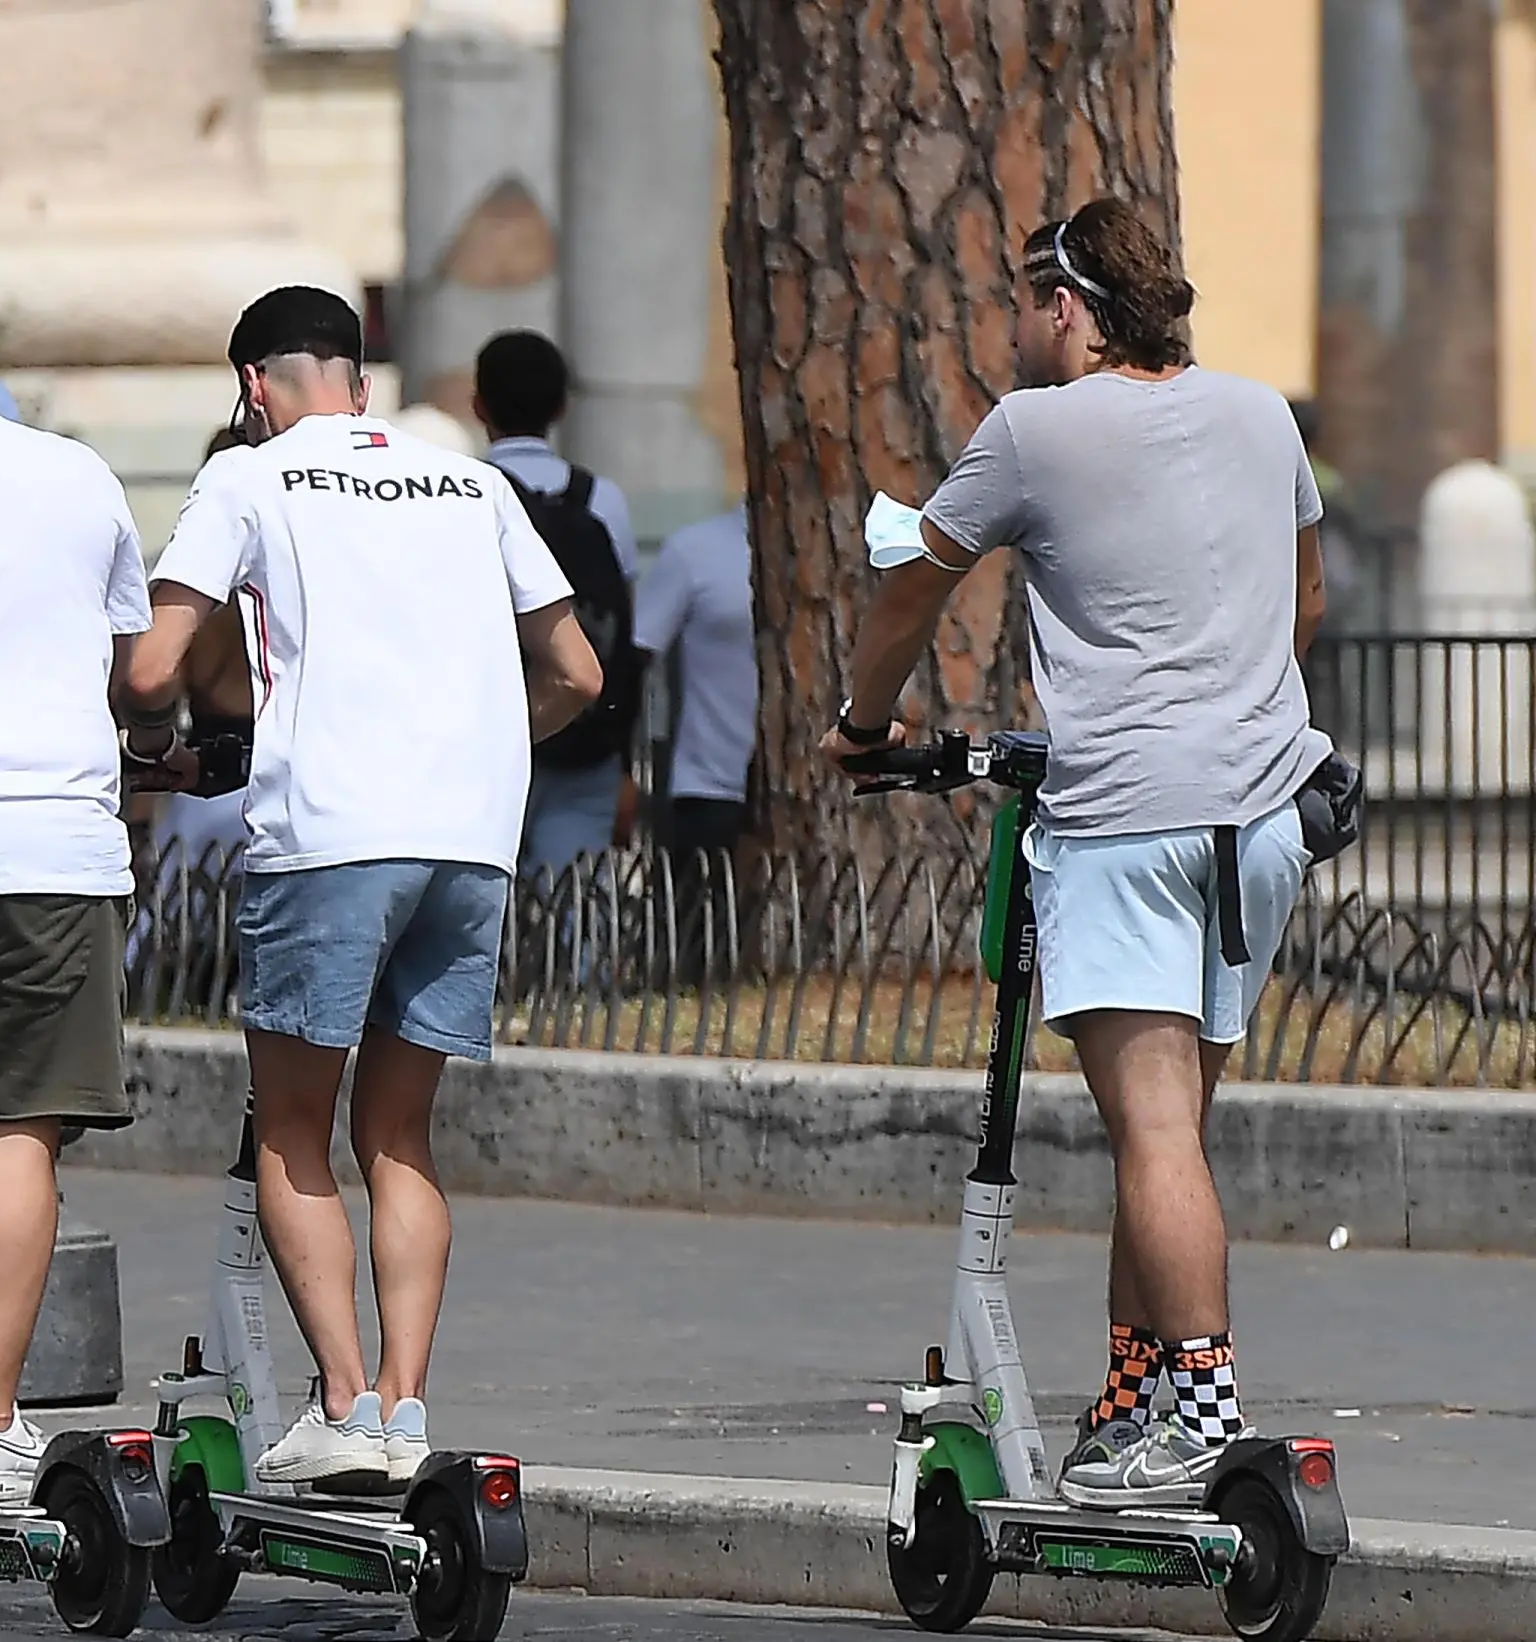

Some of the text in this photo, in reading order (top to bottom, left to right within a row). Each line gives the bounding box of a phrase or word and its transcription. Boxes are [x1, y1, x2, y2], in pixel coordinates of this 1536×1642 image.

[281, 469, 483, 501] PETRONAS
[1109, 1338, 1161, 1363] SIX
[1175, 1345, 1234, 1369] 3SIX
